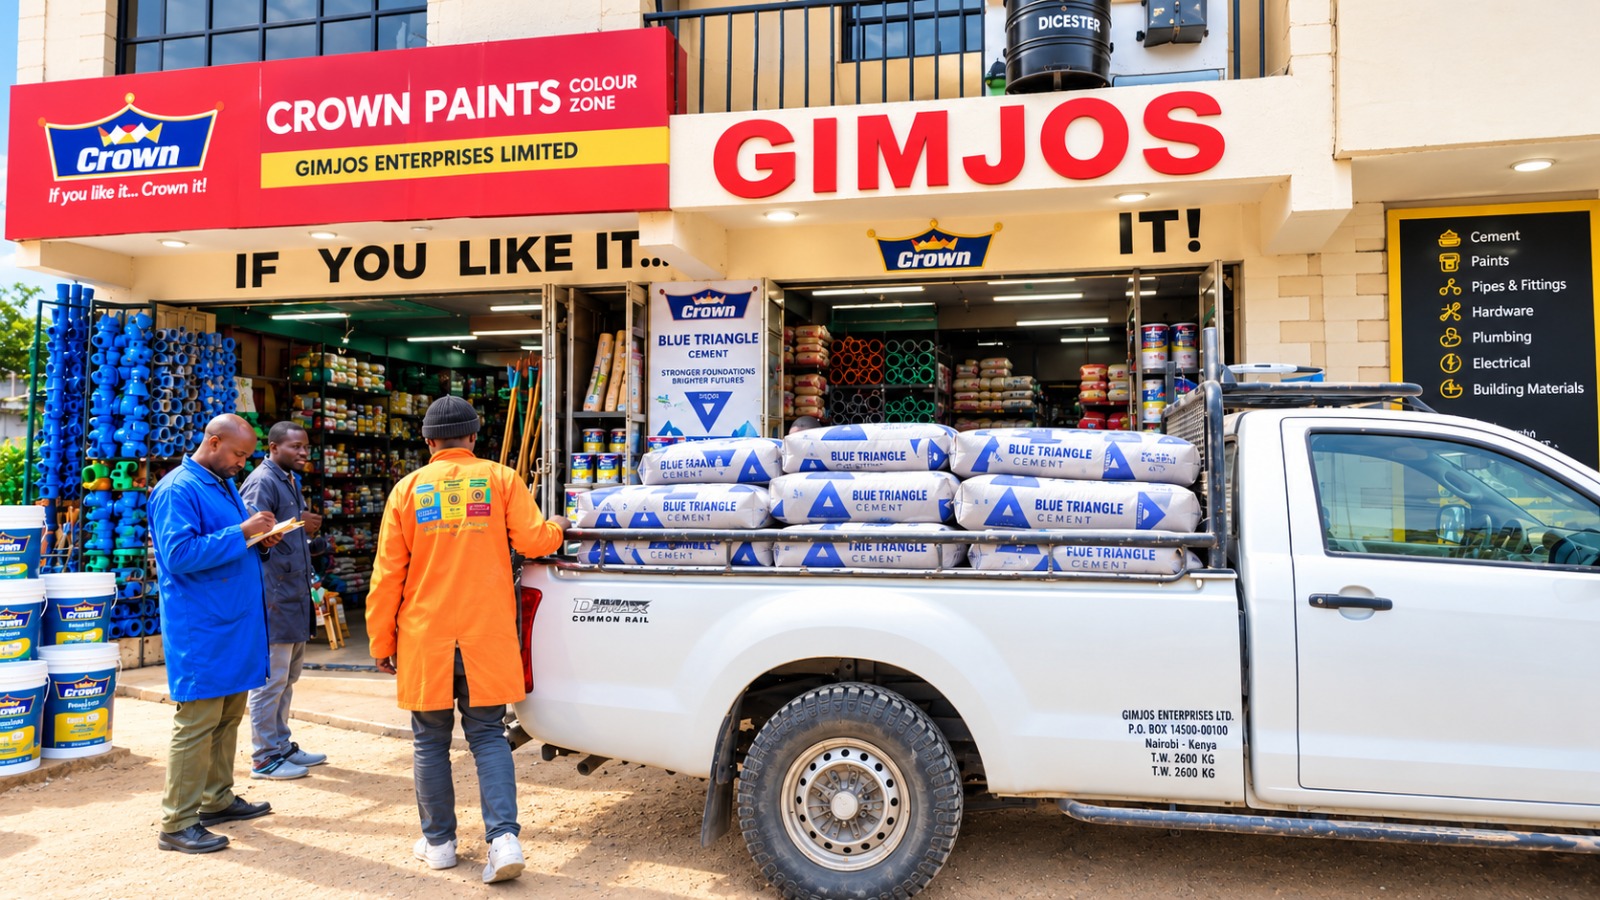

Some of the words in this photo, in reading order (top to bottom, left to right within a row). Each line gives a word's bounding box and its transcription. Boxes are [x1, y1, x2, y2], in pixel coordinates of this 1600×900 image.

[1038, 14, 1101, 33] DICESTER
[569, 74, 638, 93] COLOUR
[266, 92, 411, 135] CROWN
[425, 79, 562, 122] PAINTS
[569, 94, 616, 113] ZONE
[713, 91, 1226, 199] GIMJOS
[76, 144, 181, 173] Crown
[295, 157, 369, 177] GIMJOS
[375, 146, 495, 171] ENTERPRISES
[501, 141, 579, 163] LIMITED
[49, 188, 59, 203] If
[61, 190, 87, 206] you
[91, 184, 115, 201] like
[118, 183, 139, 199] it...
[141, 181, 189, 196] Crown
[192, 178, 208, 194] it!
[1119, 208, 1202, 255] IT!
[1470, 230, 1521, 243] Cement
[235, 251, 279, 288] IF
[318, 242, 427, 284] YOU
[459, 233, 574, 277] LIKE
[897, 250, 971, 270] Crown
[1471, 255, 1510, 267] Paints
[1472, 281, 1505, 295] Pipes
[1508, 280, 1518, 291] &
[1521, 278, 1567, 294] Fittings
[681, 305, 736, 319] Crown
[1472, 305, 1534, 318] Hardware
[658, 334, 691, 346] BLUE
[694, 332, 759, 345] TRIANGLE
[1472, 331, 1532, 344] Plumbing
[688, 350, 729, 358] CEMENT
[1473, 356, 1531, 369] Electrical
[661, 369, 701, 377] STRONGER
[702, 367, 756, 376] FOUNDATIONS
[672, 377, 709, 385] BRIGHTER
[710, 376, 745, 384] FUTURES
[1473, 383, 1524, 397] Building
[1527, 382, 1585, 395] Materials
[831, 451, 855, 461] BLUE
[857, 451, 907, 461] TRIANGLE
[1008, 444, 1035, 456] BLUE
[1038, 446, 1093, 460] TRIANGLE
[660, 460, 683, 470] BLUE
[1013, 457, 1064, 469] CEMENT
[852, 490, 877, 500] BLUE
[879, 490, 928, 501] TRIANGLE
[663, 501, 686, 512] BLUE
[689, 501, 736, 512] TRIANGLE
[856, 503, 903, 512] CEMENT
[1035, 499, 1063, 511] BLUE
[1066, 500, 1124, 515] TRIANGLE
[667, 513, 711, 522] CEMENT
[1037, 513, 1092, 525] CEMENT
[851, 554, 902, 563] CEMENT
[1096, 548, 1156, 561] TRIANGLE
[1071, 560, 1128, 570] CEMENT
[1122, 710, 1155, 720] GIMJOS
[1158, 710, 1214, 721] ENTERPRISES
[1216, 711, 1234, 721] LTD.
[1128, 724, 1146, 734] P.O.
[1149, 724, 1167, 734] BOX
[1171, 725, 1228, 735] 14500-00100
[1145, 739, 1179, 749] Nairobi
[1188, 740, 1217, 751] Kenya
[1151, 753, 1171, 763] T.W.
[1174, 754, 1197, 764] 2600
[1202, 755, 1215, 764] KG
[1152, 767, 1171, 777] T.W.
[1175, 767, 1198, 778] 2600
[1202, 768, 1215, 778] KG
